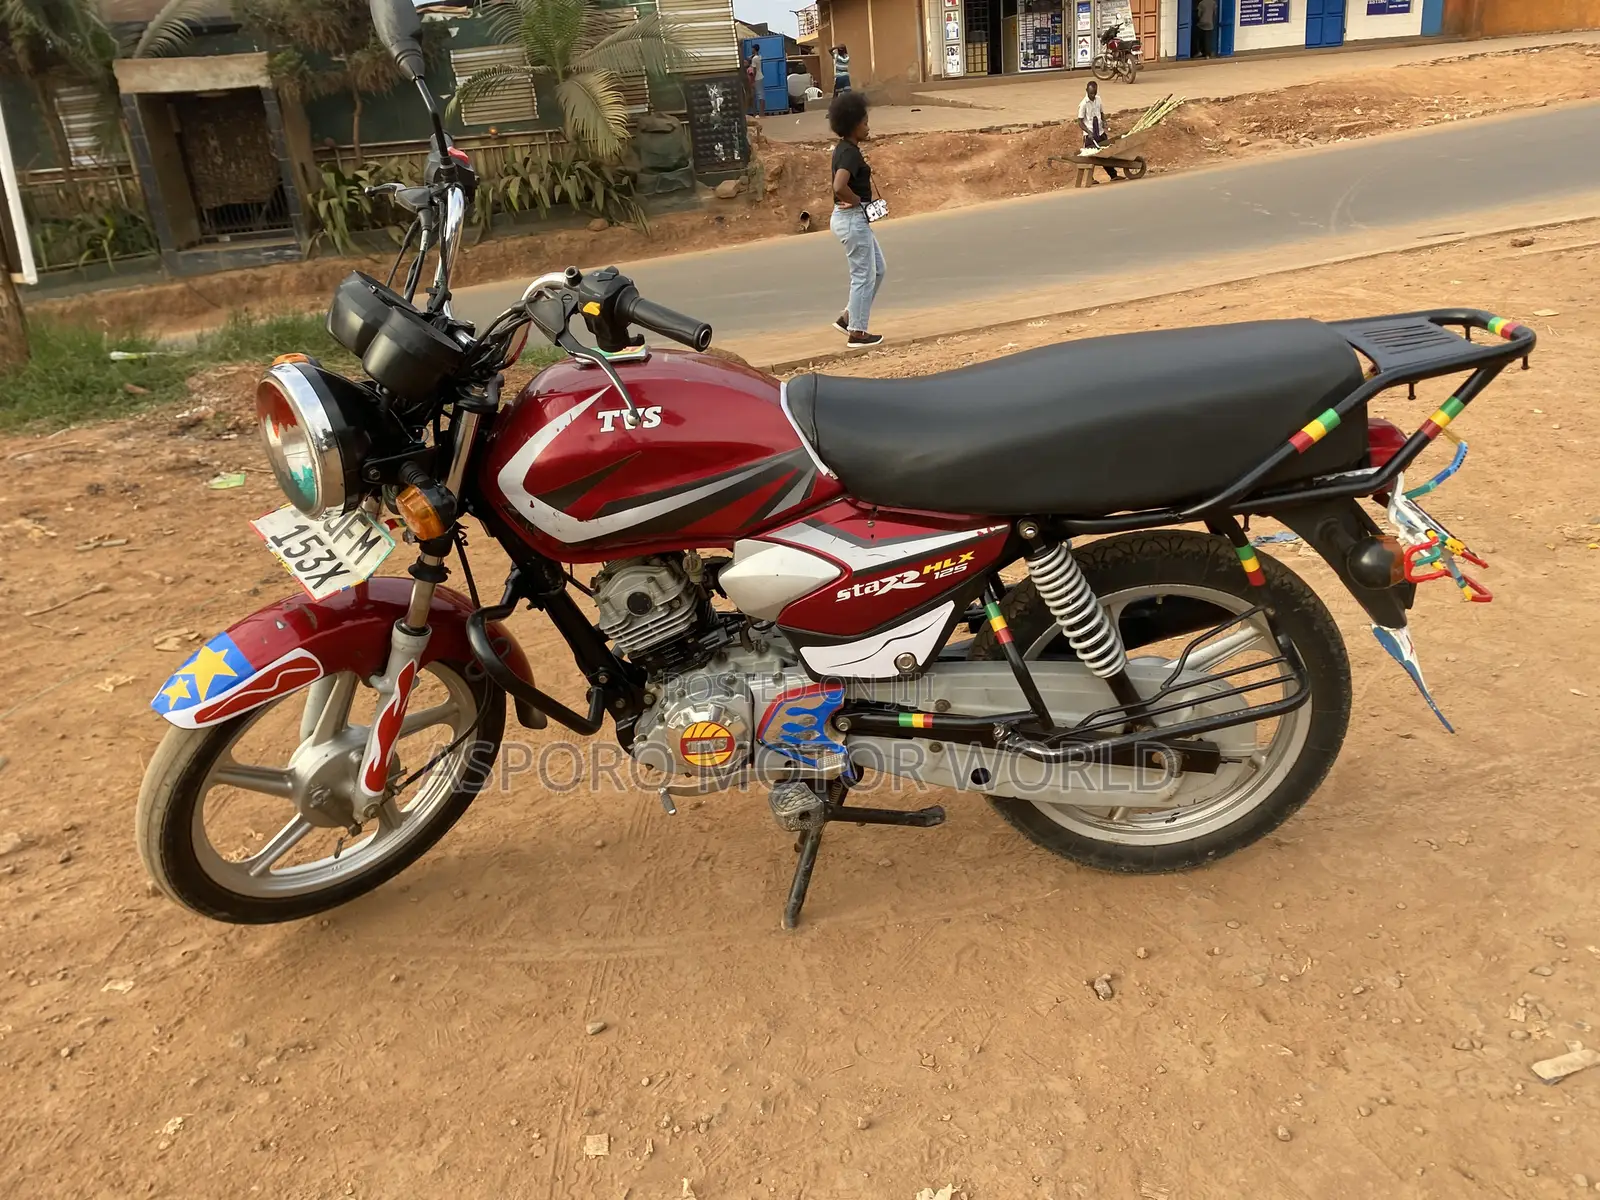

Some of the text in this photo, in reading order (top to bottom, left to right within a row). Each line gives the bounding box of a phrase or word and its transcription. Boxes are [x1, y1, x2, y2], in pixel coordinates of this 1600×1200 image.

[597, 405, 663, 433] TVS
[270, 524, 351, 590] 153X
[923, 551, 975, 575] HLX
[933, 562, 969, 581] 125
